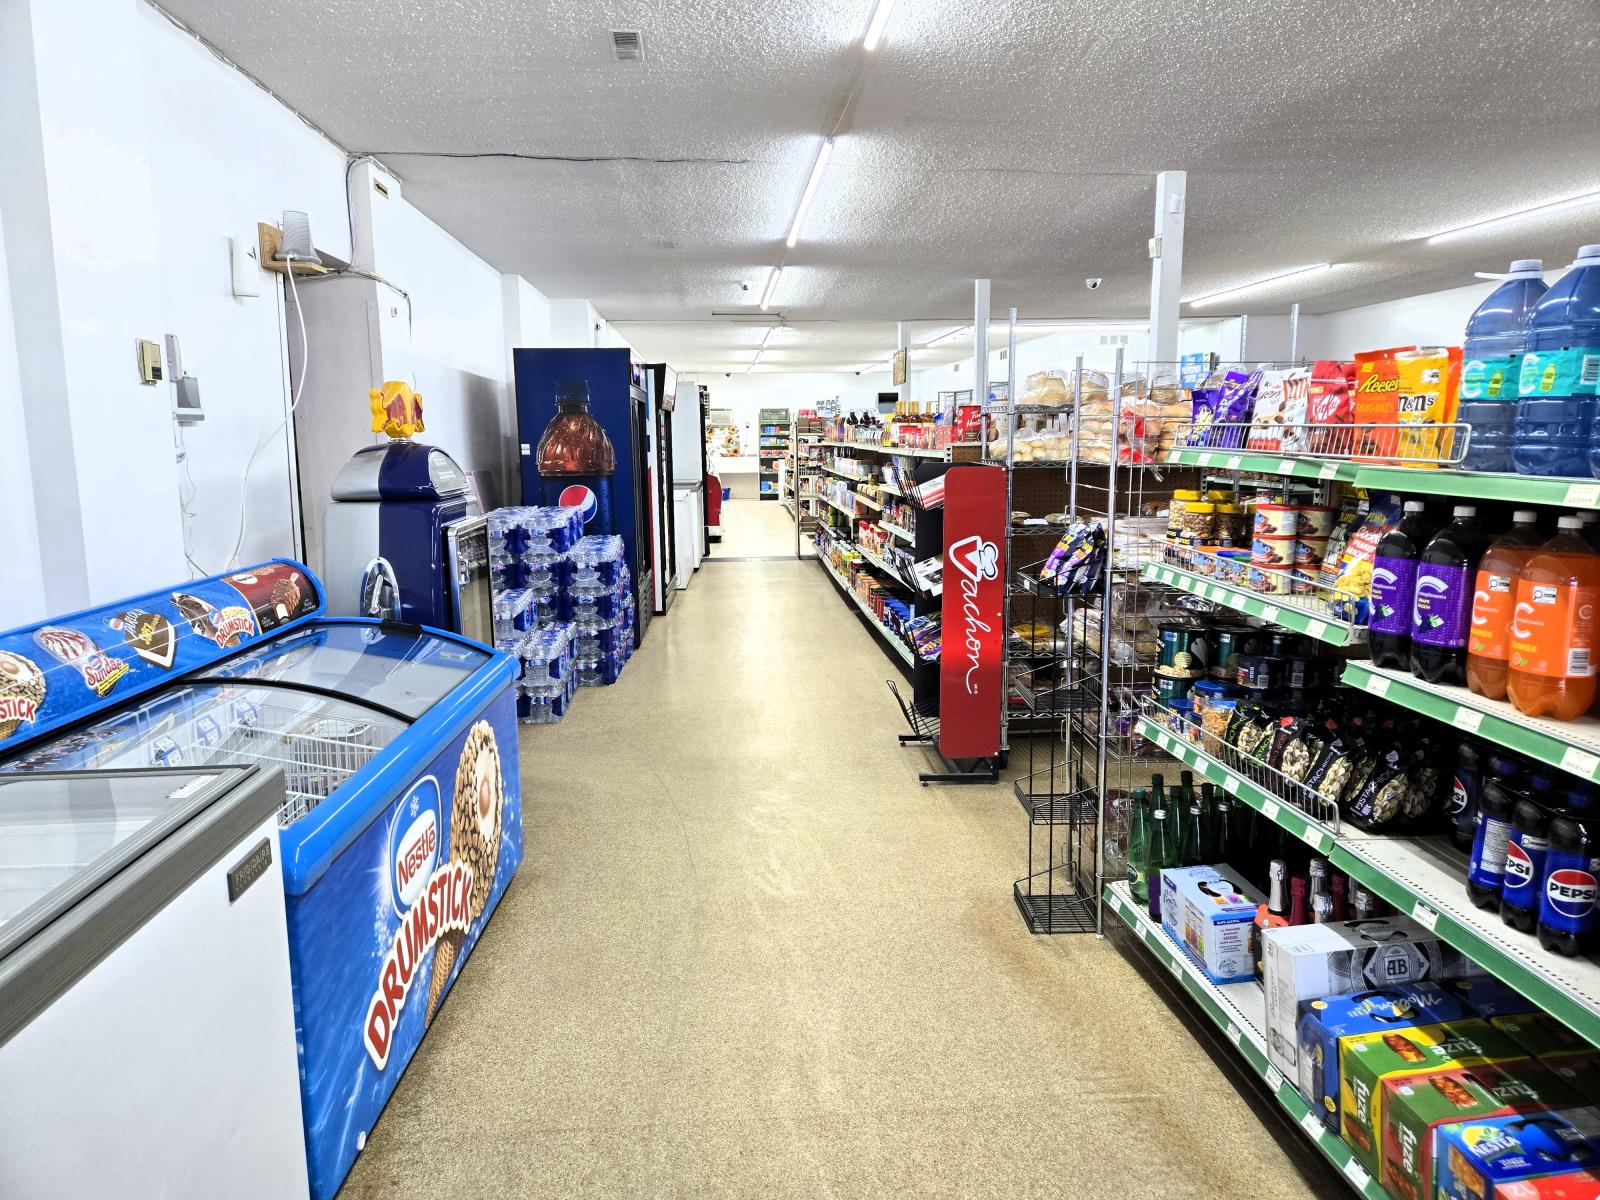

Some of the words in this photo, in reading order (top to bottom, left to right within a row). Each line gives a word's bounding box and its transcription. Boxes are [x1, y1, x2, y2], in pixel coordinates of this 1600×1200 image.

[216, 618, 254, 648] DRUMSTICK
[947, 535, 991, 695] Vachon
[397, 821, 436, 893] Nestlé
[1550, 881, 1595, 900] PEPSI
[368, 864, 474, 1060] DRUMSTICK
[1357, 1079, 1369, 1123] fuze
[1403, 1123, 1418, 1175] fuze
[1469, 1135, 1521, 1158] NESTEA
